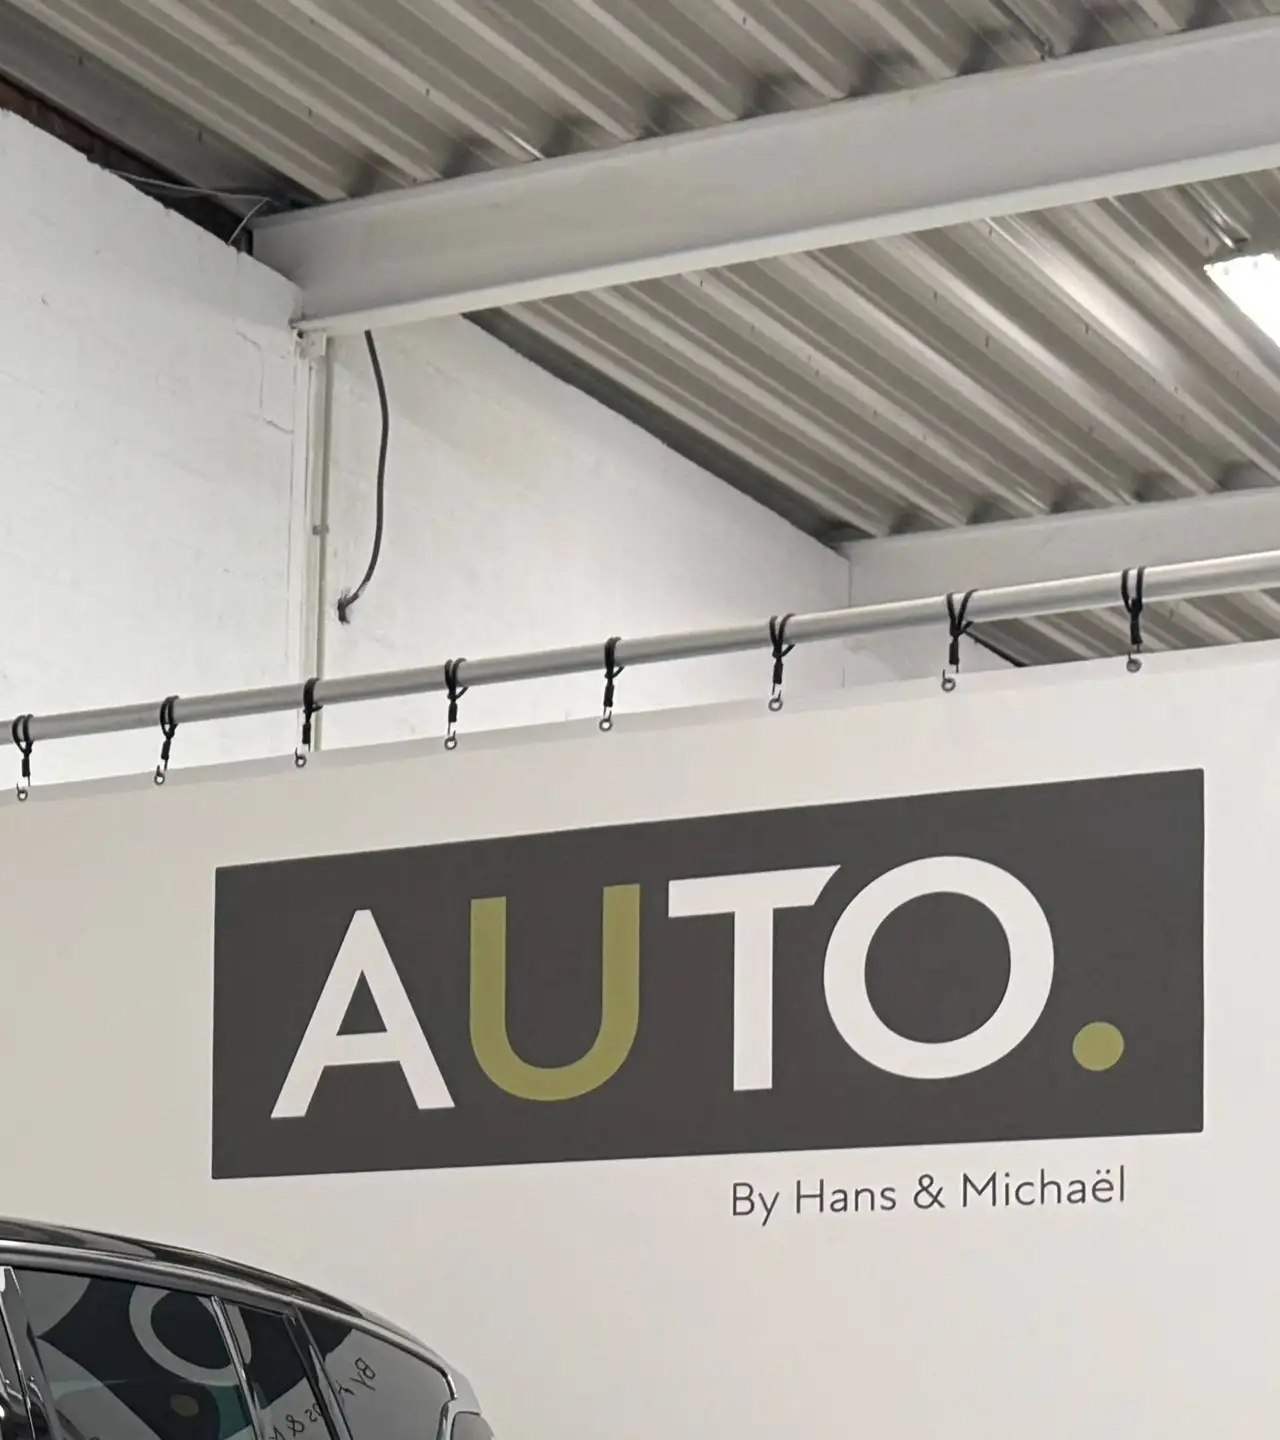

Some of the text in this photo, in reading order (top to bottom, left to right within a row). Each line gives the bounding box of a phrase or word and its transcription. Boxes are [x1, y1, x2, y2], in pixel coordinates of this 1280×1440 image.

[270, 855, 1125, 1119] AUTO.
[731, 1164, 1126, 1227] By Hans & Michaël
